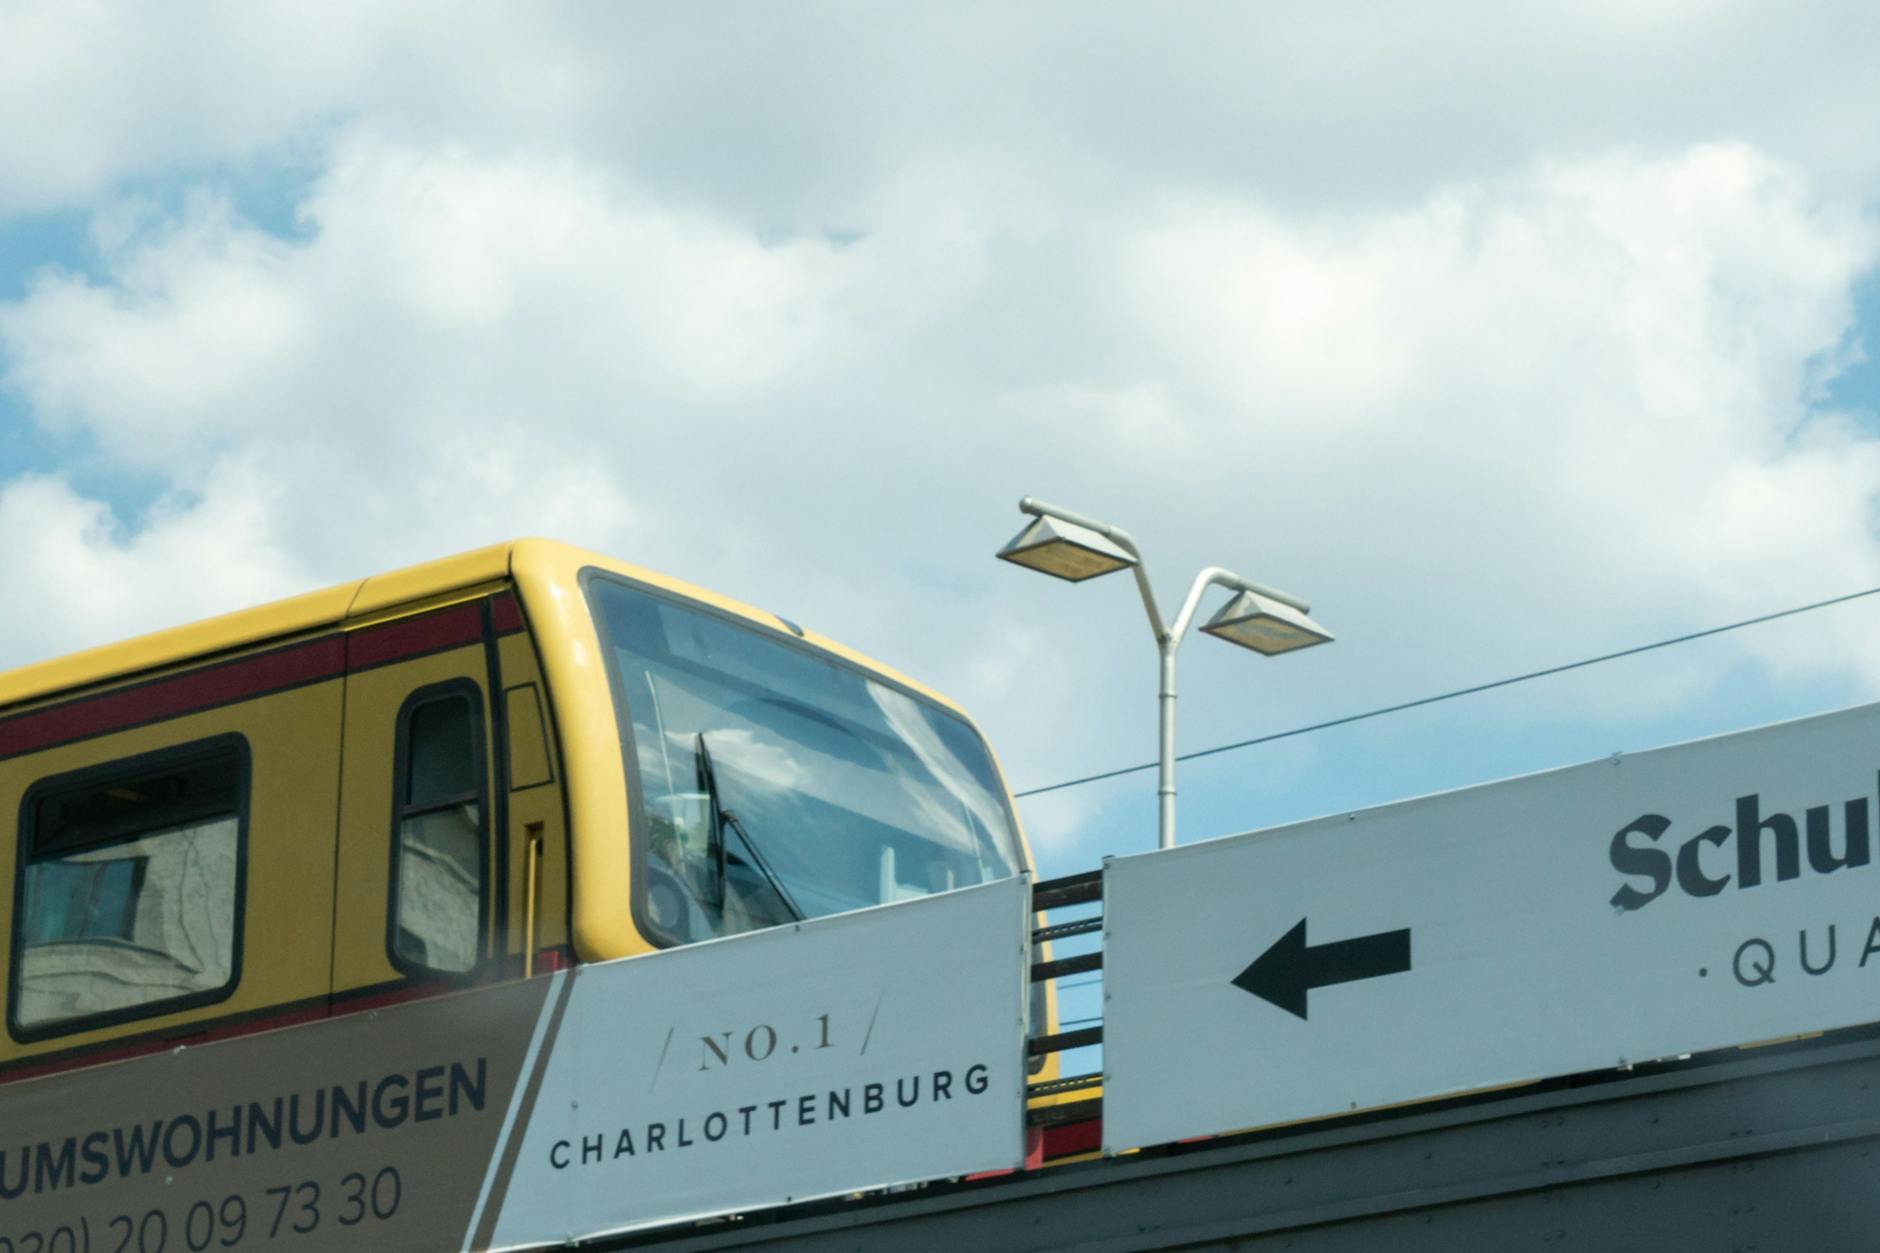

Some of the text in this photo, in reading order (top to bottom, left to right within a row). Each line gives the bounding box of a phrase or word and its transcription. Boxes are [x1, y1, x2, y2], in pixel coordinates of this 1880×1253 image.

[1608, 769, 1880, 912] Schu
[698, 1013, 834, 1072] NO.1
[0, 1056, 488, 1200] UMSWOHNUNGEN
[548, 1062, 990, 1171] CHARLOTTENBURG
[109, 1208, 168, 1253] 20
[185, 1194, 248, 1252] 09
[265, 1180, 321, 1239] 73
[338, 1165, 402, 1226] 30
